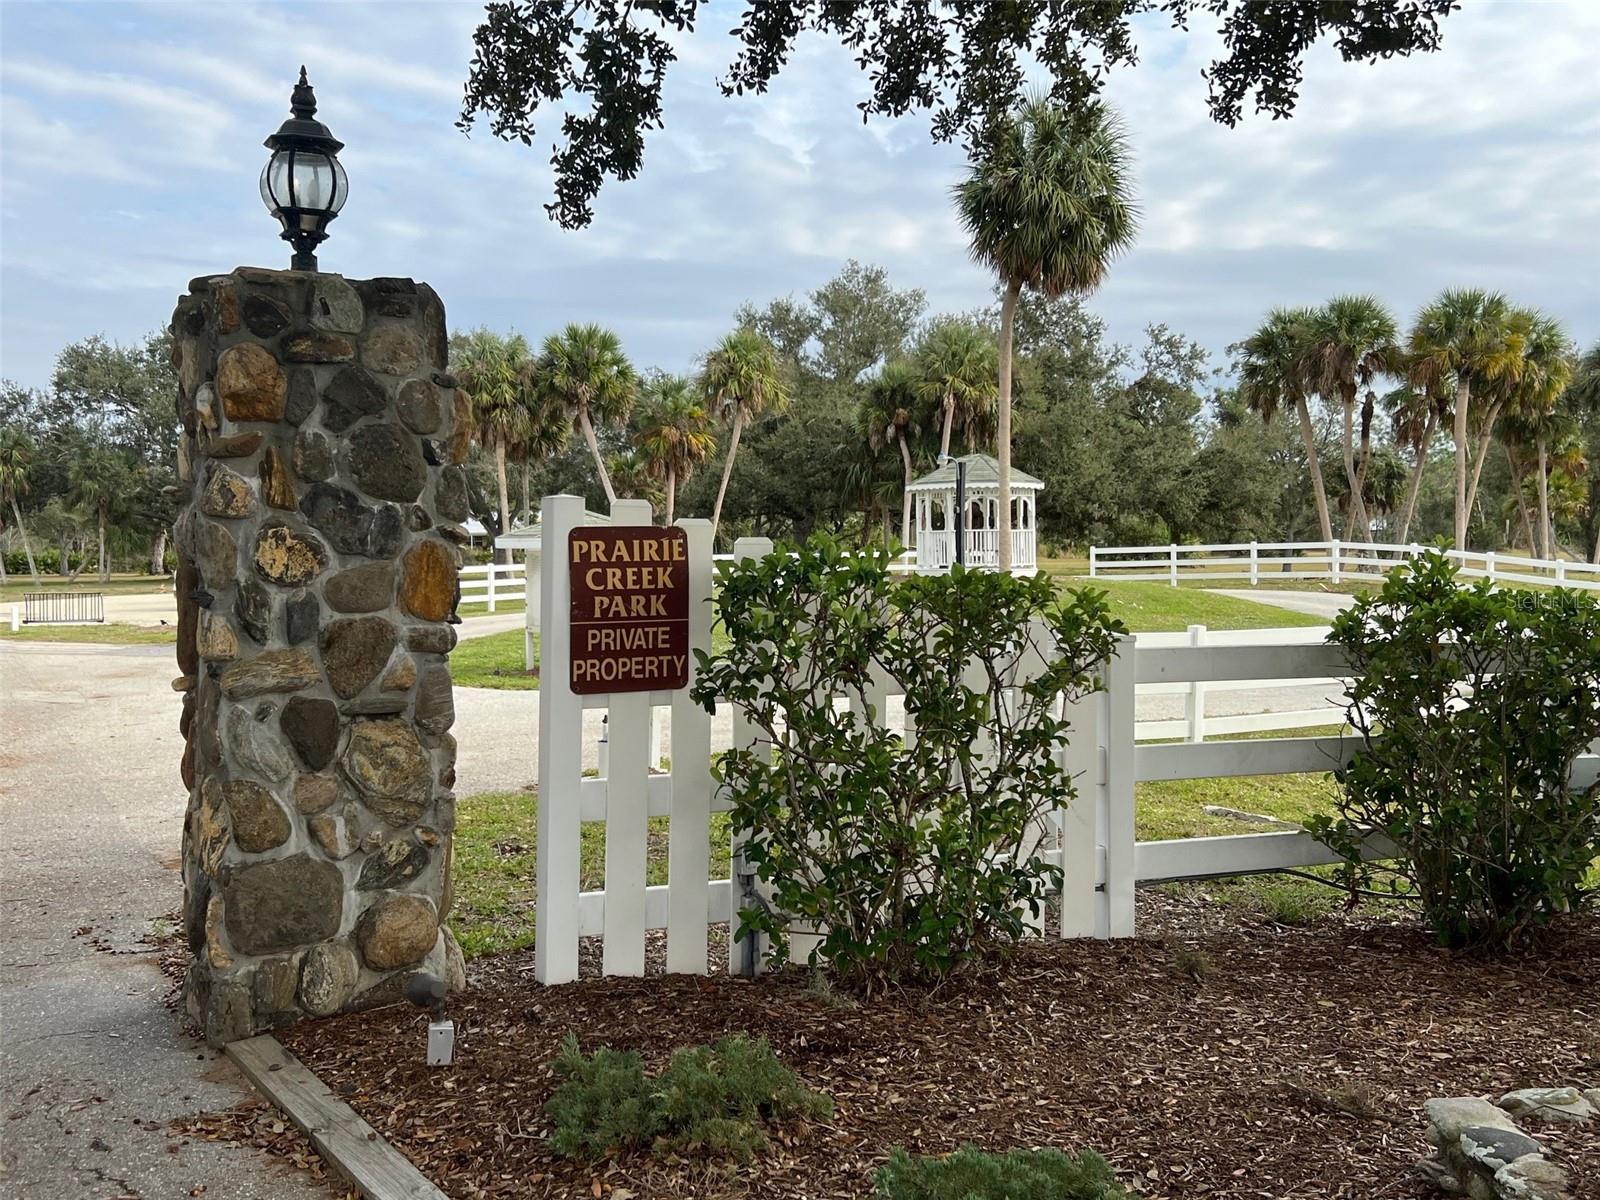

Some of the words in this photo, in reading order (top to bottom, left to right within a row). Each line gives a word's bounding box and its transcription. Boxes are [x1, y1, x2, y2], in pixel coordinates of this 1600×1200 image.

[572, 538, 686, 563] PRAIRIE
[585, 566, 674, 591] CREEK
[593, 594, 668, 618] PARK
[587, 626, 670, 652] PRIVATE
[572, 654, 686, 682] PROPERTY
